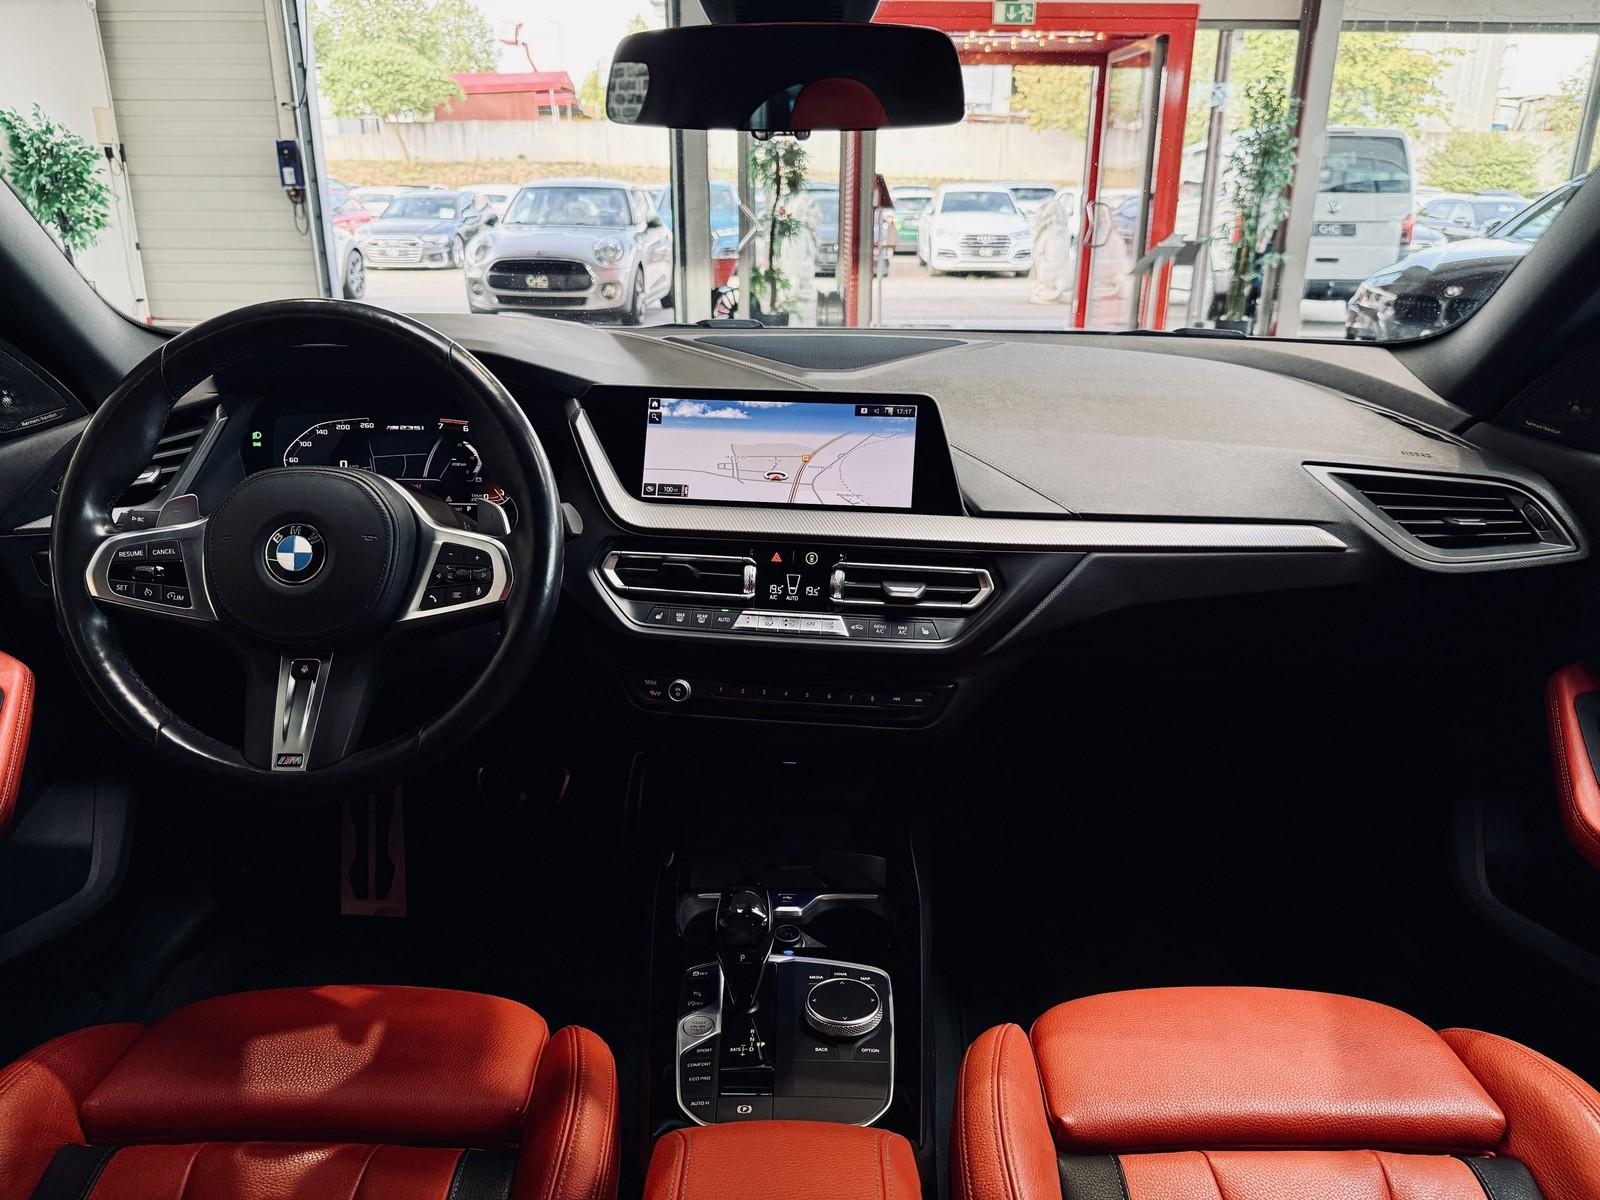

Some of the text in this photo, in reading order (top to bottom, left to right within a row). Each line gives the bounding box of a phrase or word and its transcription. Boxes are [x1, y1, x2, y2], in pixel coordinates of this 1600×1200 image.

[272, 525, 321, 545] BMW
[118, 550, 144, 558] RESUME
[152, 548, 176, 556] CANCEL
